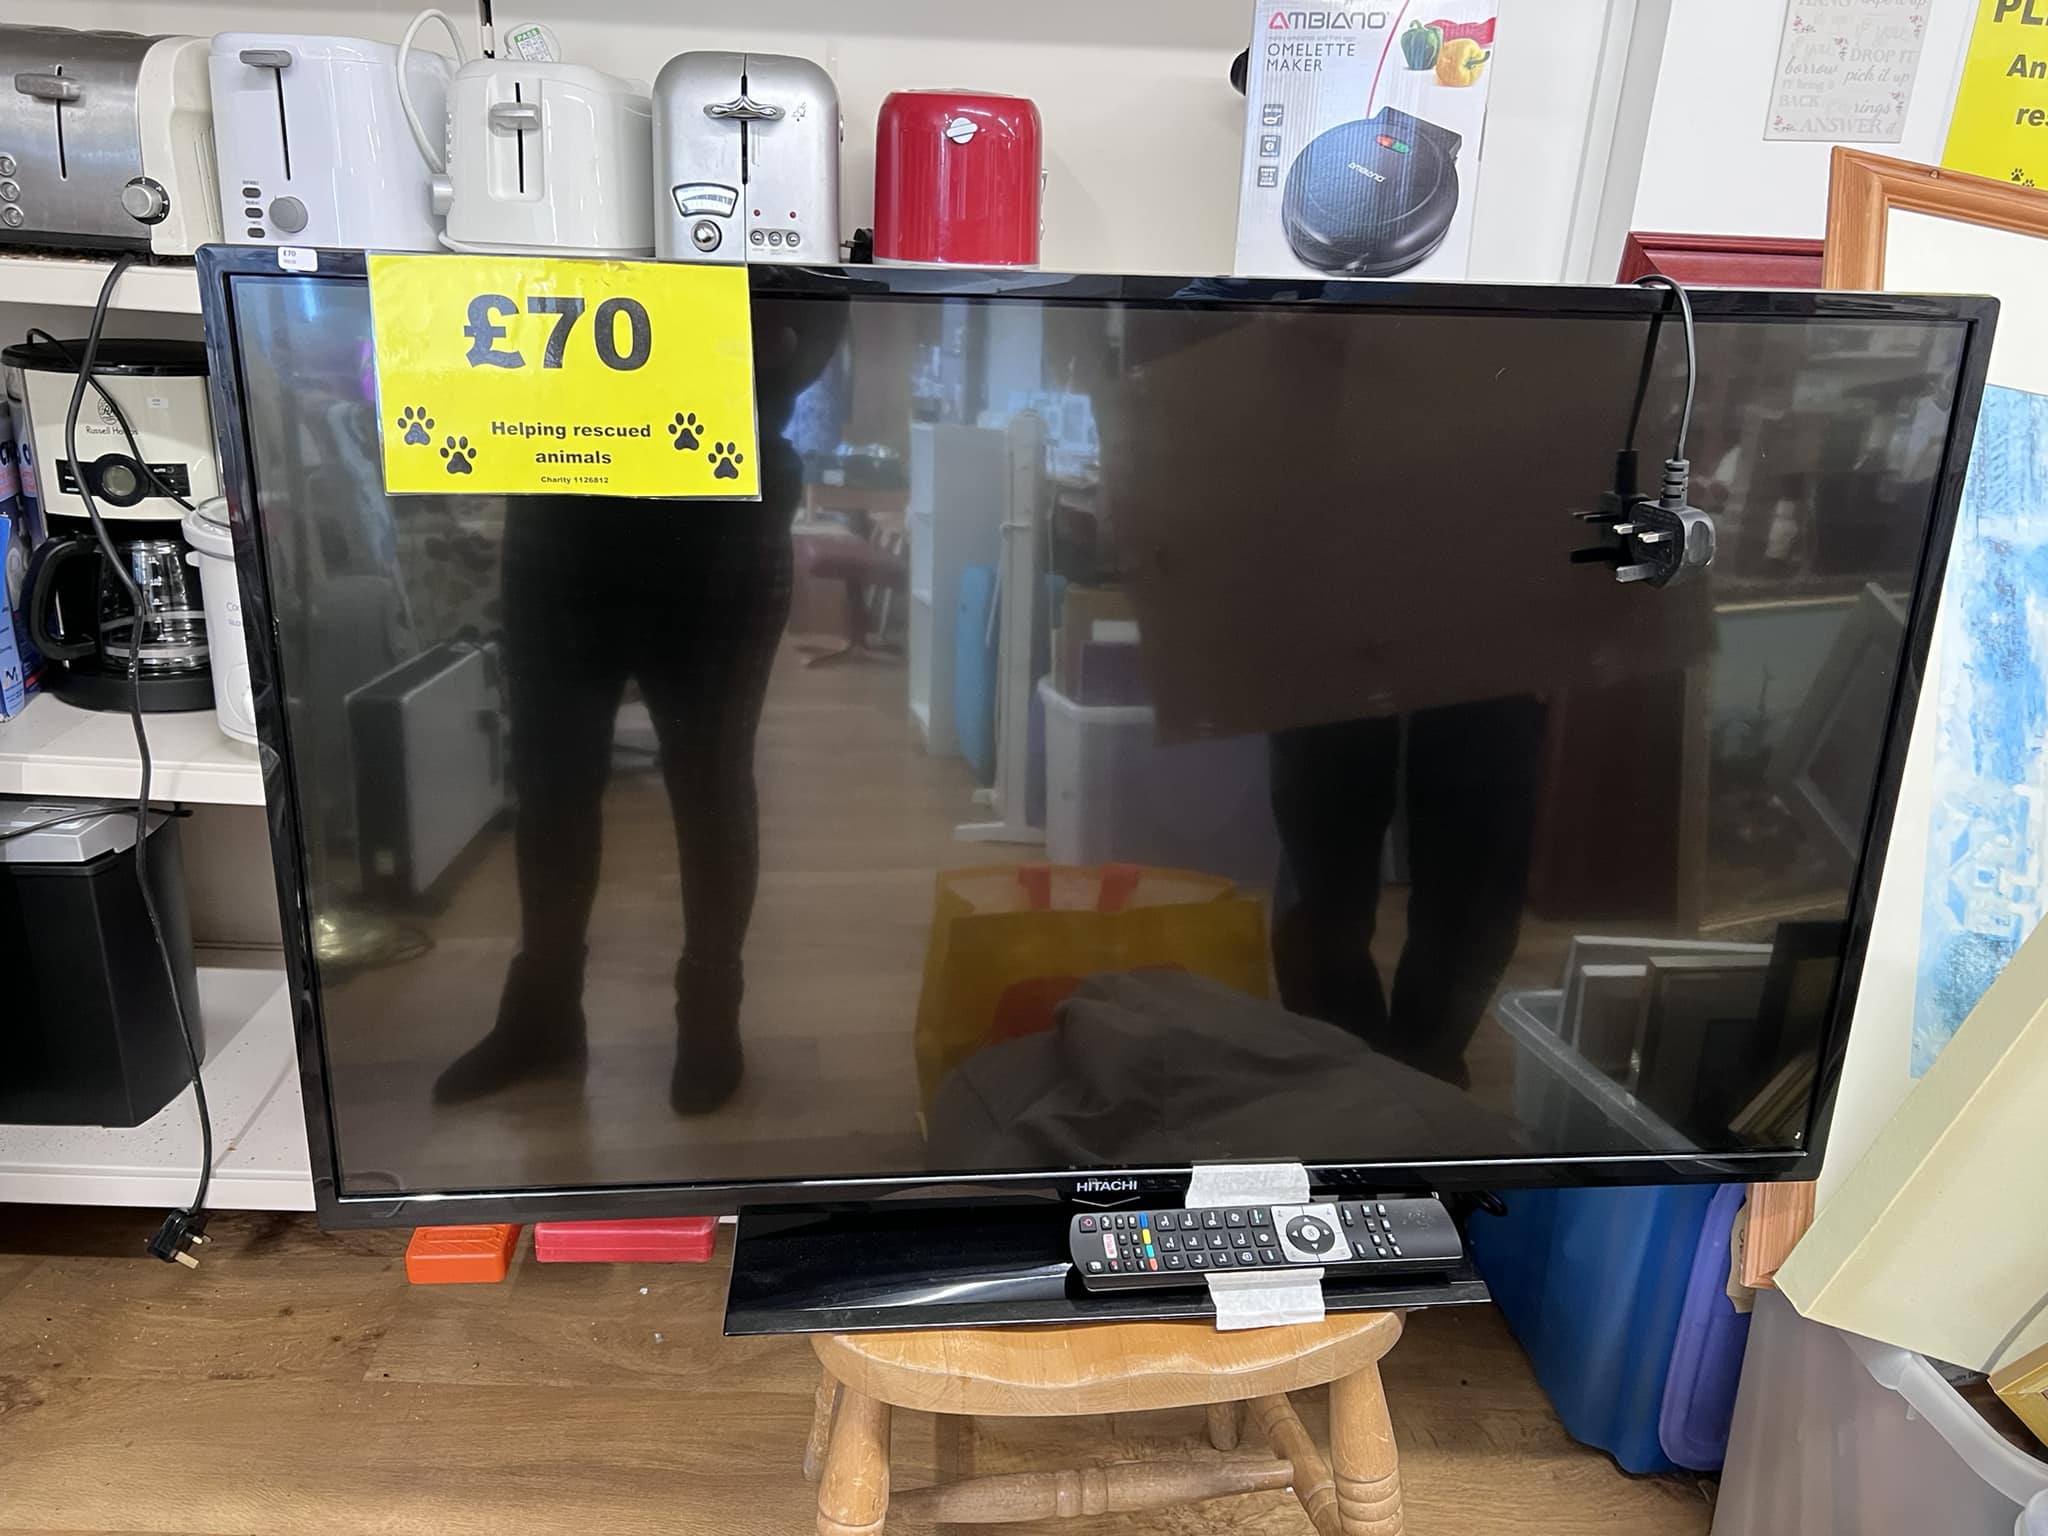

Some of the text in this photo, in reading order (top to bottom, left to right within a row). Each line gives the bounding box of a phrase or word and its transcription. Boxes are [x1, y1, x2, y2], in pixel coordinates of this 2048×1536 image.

[1268, 11, 1386, 30] AMBIANO
[1993, 0, 2048, 26] PL
[1268, 43, 1356, 57] OMELETTE
[1849, 48, 1896, 62] DROP
[1266, 58, 1322, 72] MAKER
[1784, 55, 1840, 75] borrow
[2006, 53, 2048, 79] An
[1842, 65, 1875, 87] pick
[1893, 72, 1911, 87] up
[1779, 94, 1821, 108] BACK
[1854, 99, 1891, 119] rings
[2015, 107, 2048, 127] re
[1800, 118, 1882, 134] ANSWER
[463, 294, 652, 372] £70
[85, 425, 139, 437] Russell Hos
[490, 421, 651, 440] Helping rescued
[535, 450, 612, 465] animals
[540, 475, 609, 485] Charity 1126812
[1076, 1180, 1138, 1193] HITACHI
